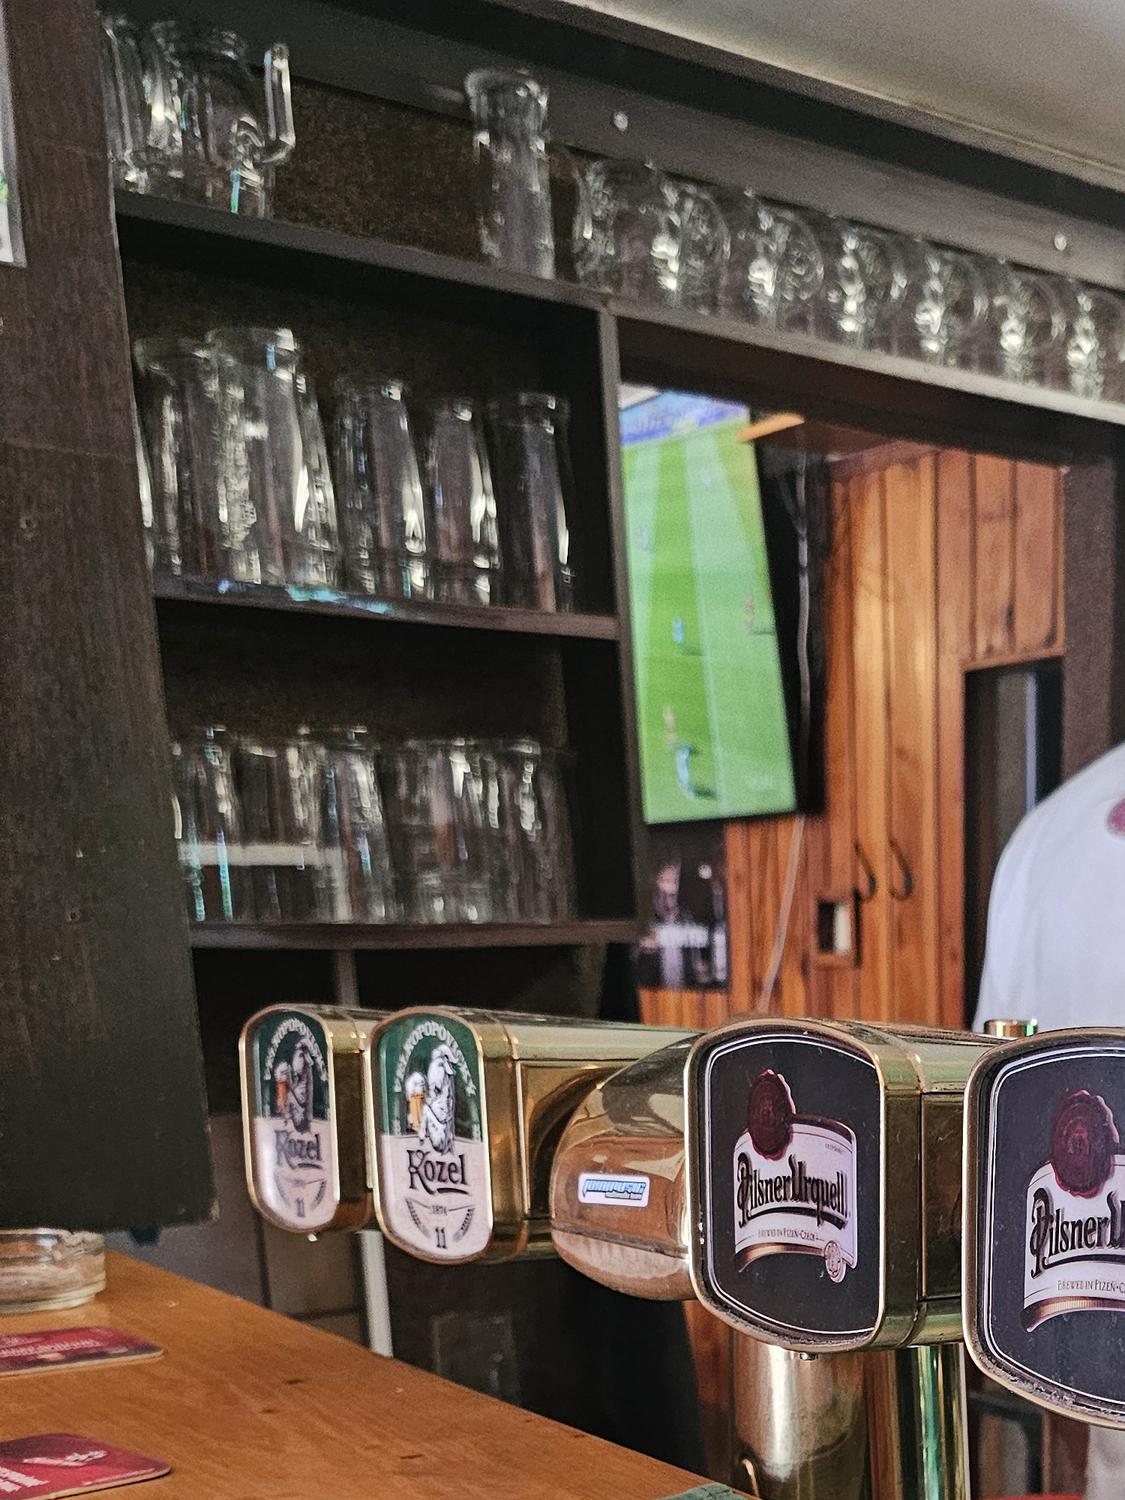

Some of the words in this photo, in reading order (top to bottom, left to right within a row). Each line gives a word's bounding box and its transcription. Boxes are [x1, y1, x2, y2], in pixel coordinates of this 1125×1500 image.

[274, 1130, 323, 1170] Kozel
[407, 1150, 470, 1195] Kozel
[737, 1152, 790, 1228] Pilsner
[789, 1154, 847, 1227] Urquell
[435, 1226, 448, 1250] 11
[1030, 1188, 1110, 1279] Pilsner
